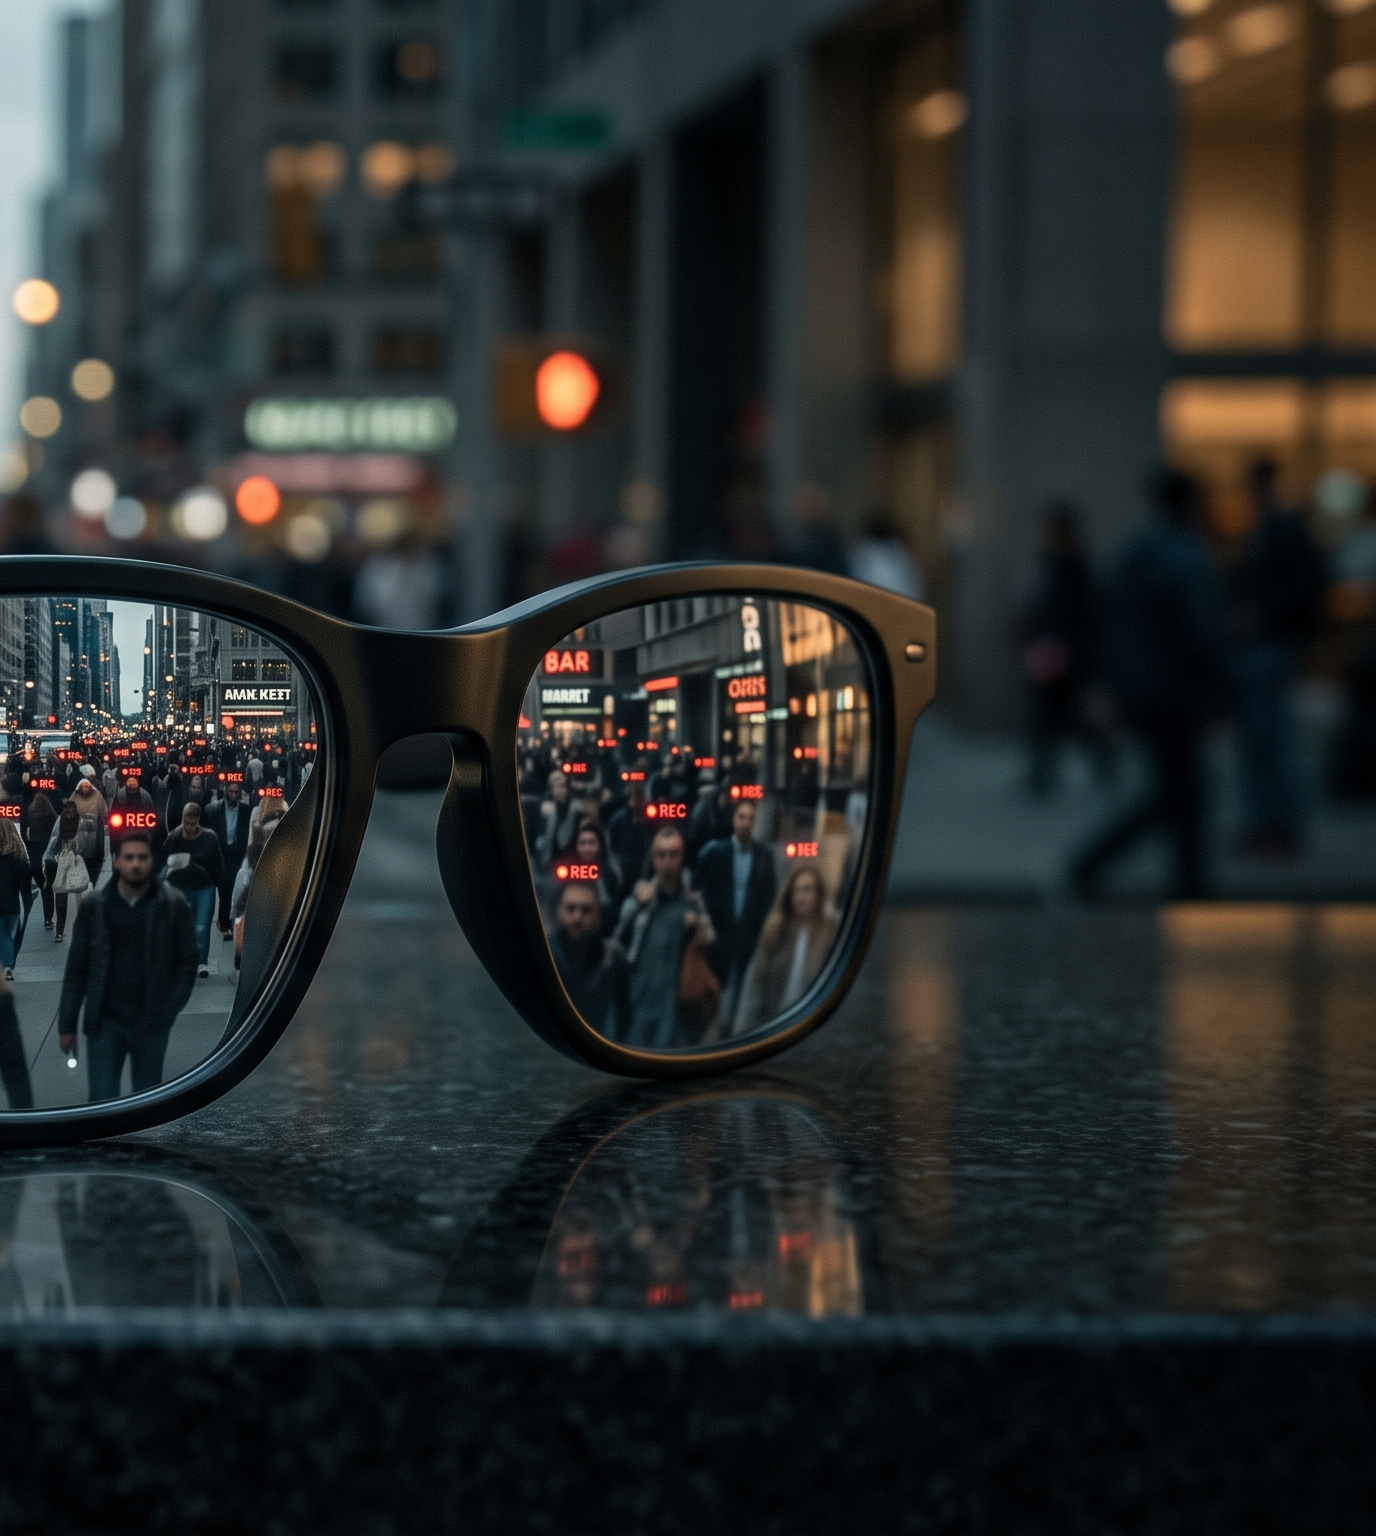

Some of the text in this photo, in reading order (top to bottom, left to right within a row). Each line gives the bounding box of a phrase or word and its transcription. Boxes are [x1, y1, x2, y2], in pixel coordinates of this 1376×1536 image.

[544, 650, 590, 673] BAR
[265, 787, 283, 797] REC
[659, 803, 686, 818] REC
[125, 813, 156, 828] REC
[570, 865, 598, 879] REC
